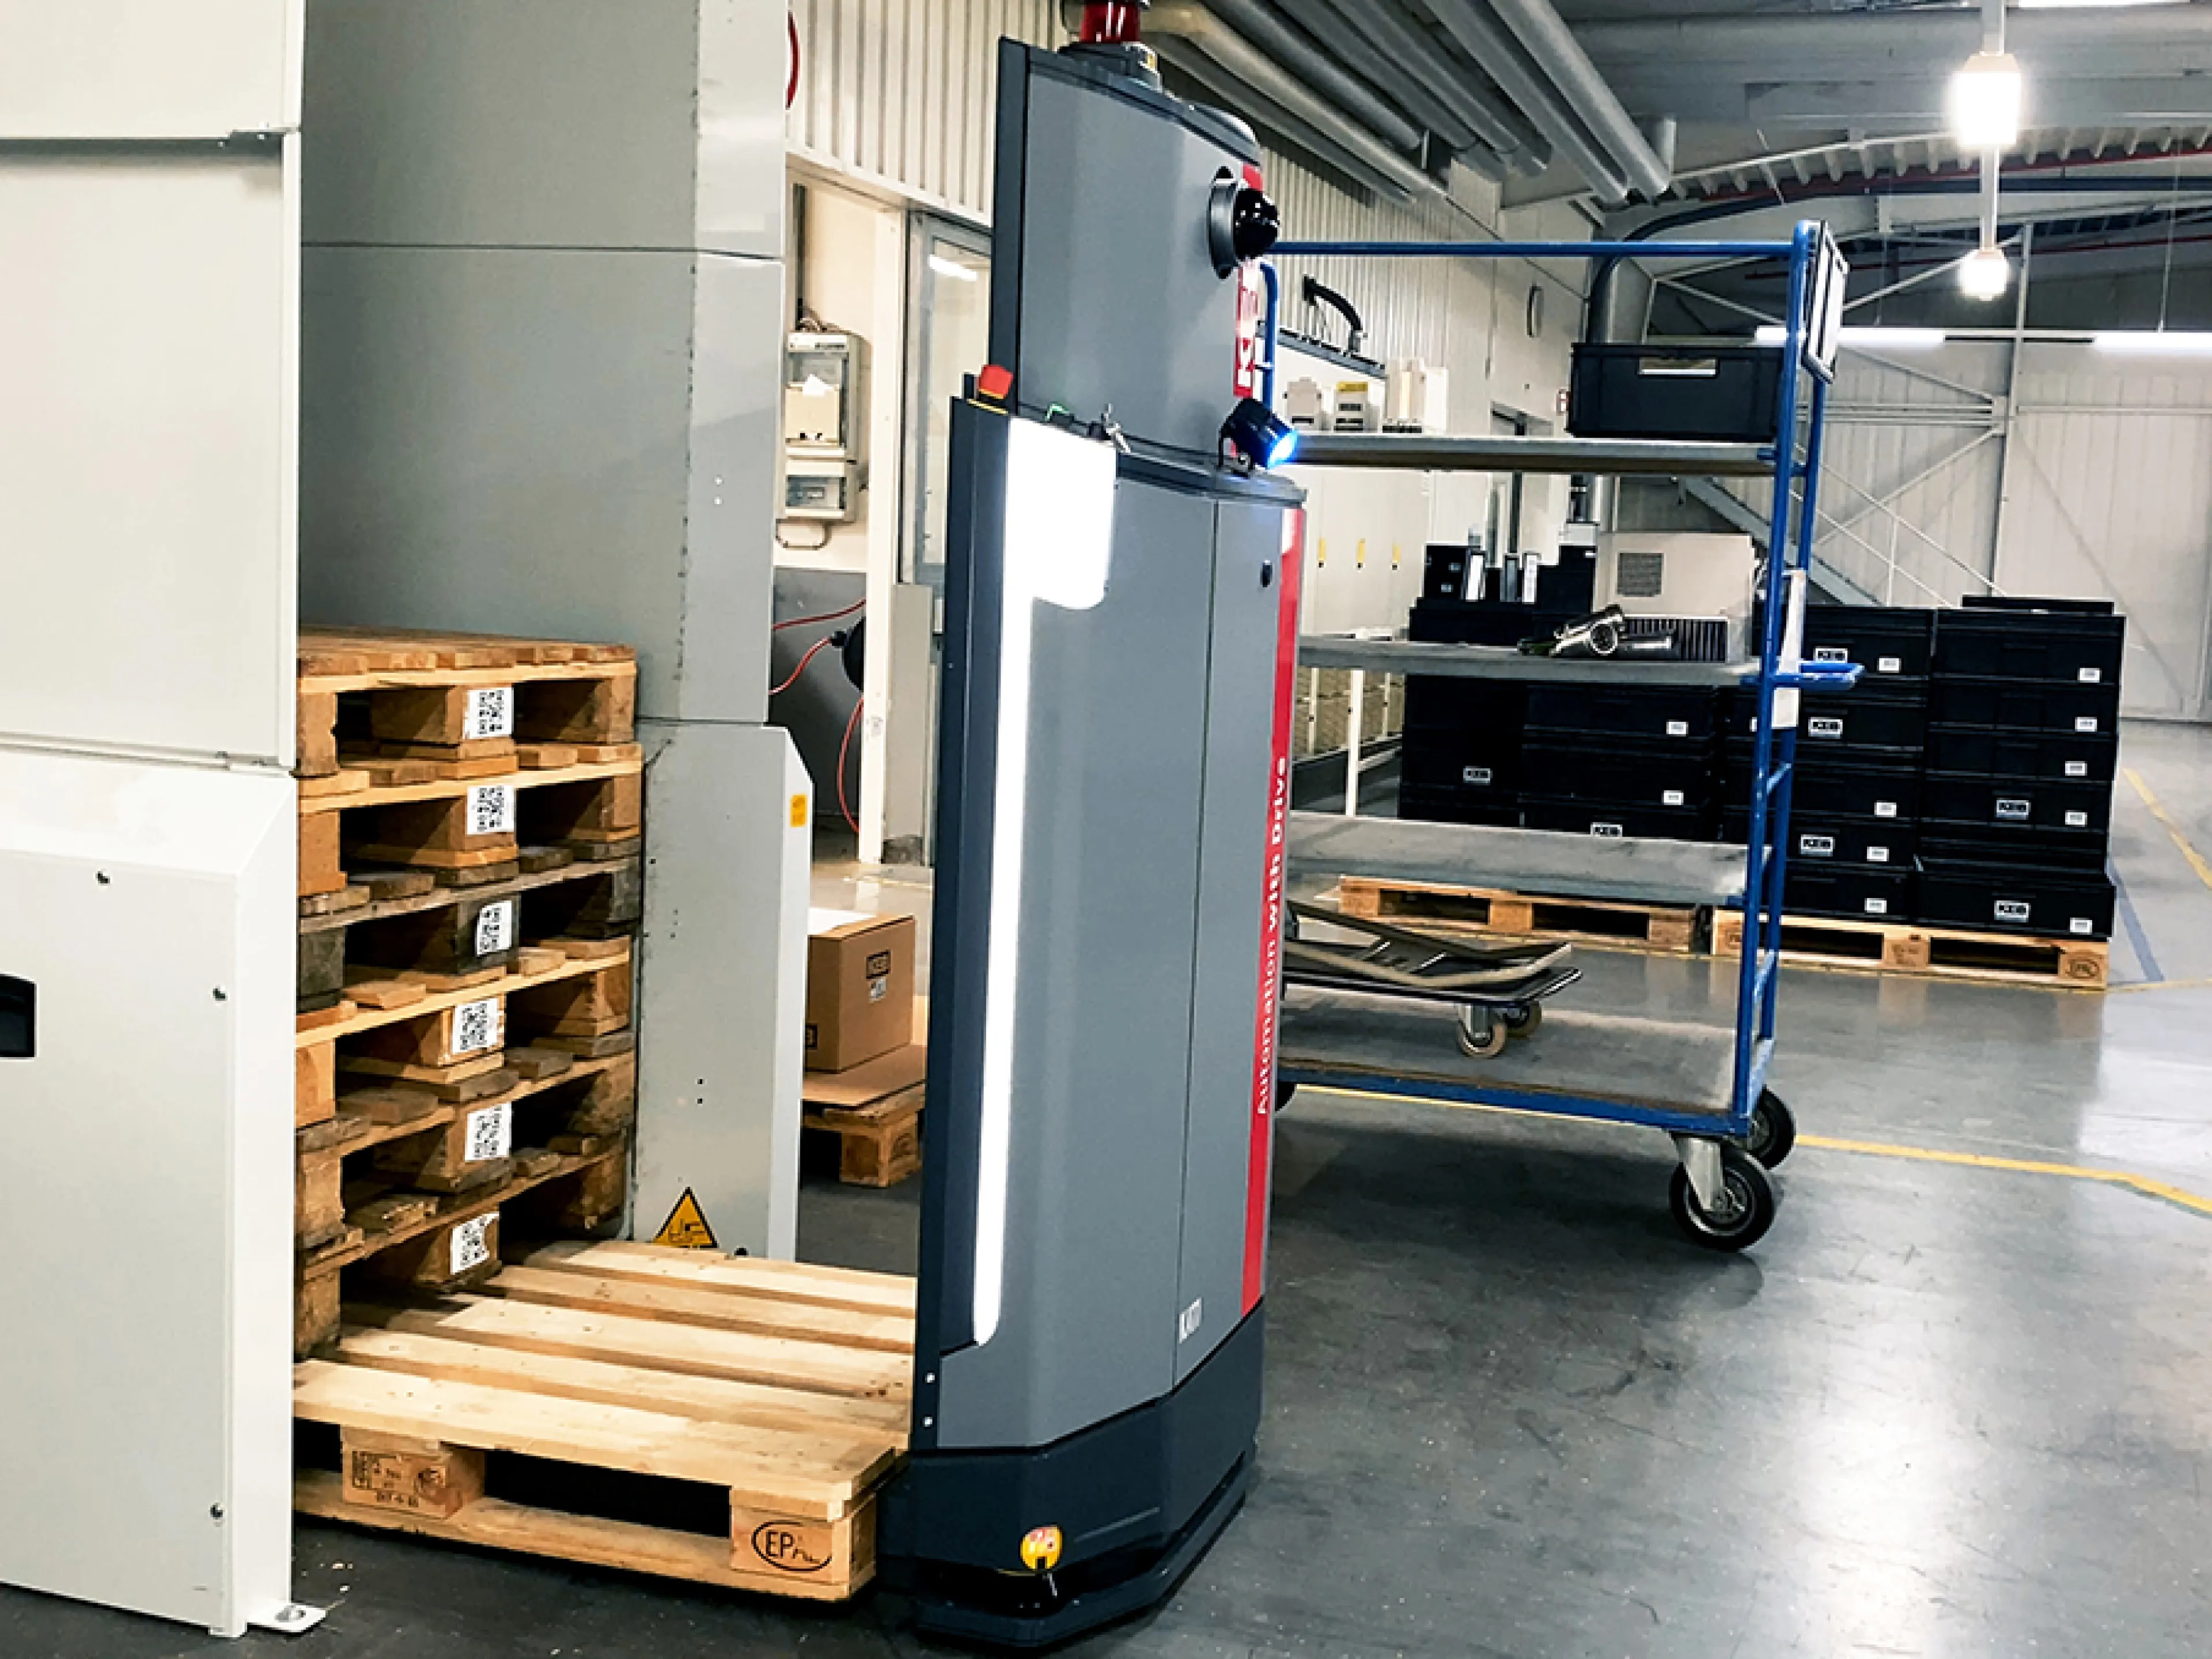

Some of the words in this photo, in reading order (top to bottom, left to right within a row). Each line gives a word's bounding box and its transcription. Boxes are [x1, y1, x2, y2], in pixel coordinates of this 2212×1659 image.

[1272, 758, 1285, 844] Drive
[1268, 854, 1281, 932] with
[1257, 939, 1275, 1113] Automation
